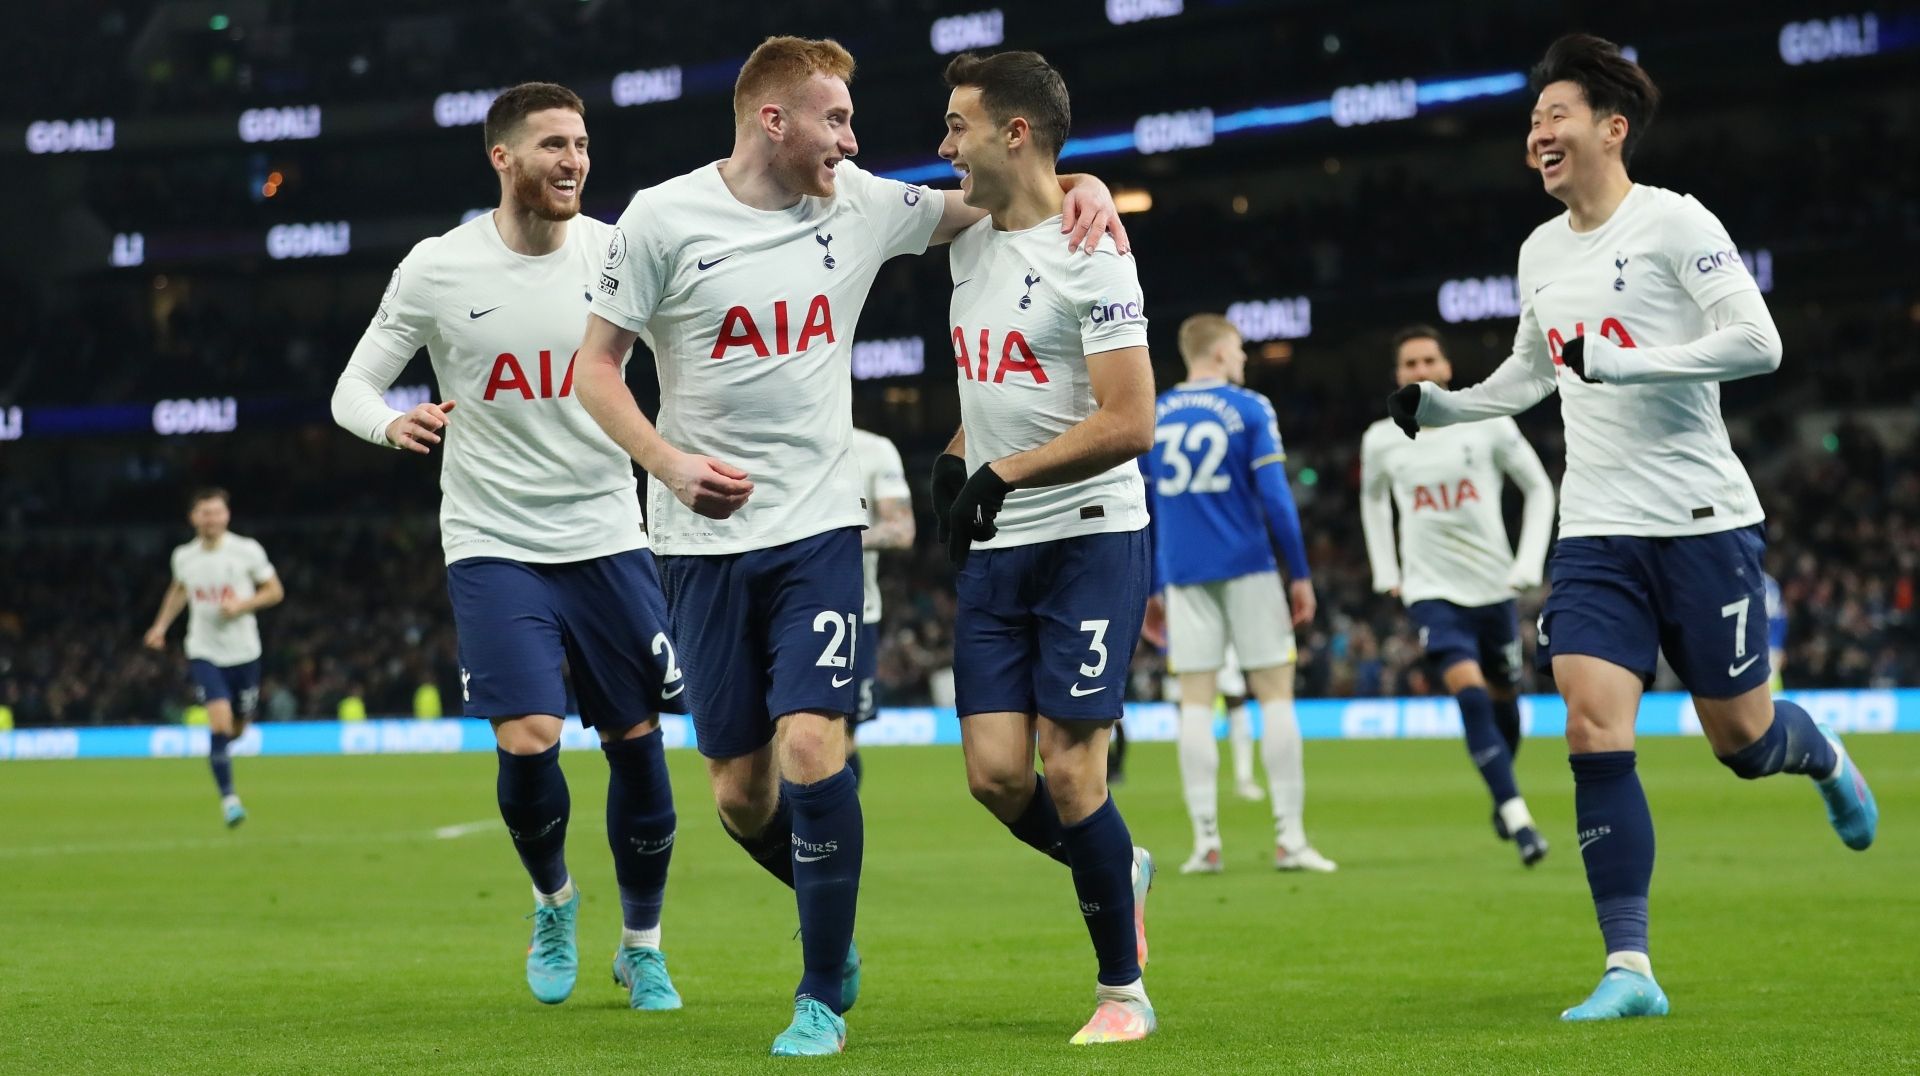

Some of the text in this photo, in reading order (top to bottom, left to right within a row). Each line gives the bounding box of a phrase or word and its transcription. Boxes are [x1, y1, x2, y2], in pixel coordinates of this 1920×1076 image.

[1779, 13, 1878, 65] GOAL!
[237, 105, 322, 142] GOAL!
[1331, 79, 1418, 127] GOAL!
[26, 118, 115, 154] GOAL!
[266, 221, 350, 259] GOAL!
[1696, 248, 1740, 274] cinc
[1090, 297, 1143, 324] cinc
[1437, 275, 1521, 323] GOAL
[710, 294, 836, 360] AIA
[952, 325, 1050, 385] AIA
[152, 397, 237, 435] GOAL!
[1154, 420, 1232, 497] 32
[1413, 478, 1482, 512] AIA
[813, 610, 857, 671] 21
[1080, 619, 1110, 678] 3
[1721, 597, 1750, 659] 7
[791, 832, 838, 853] SPURS
